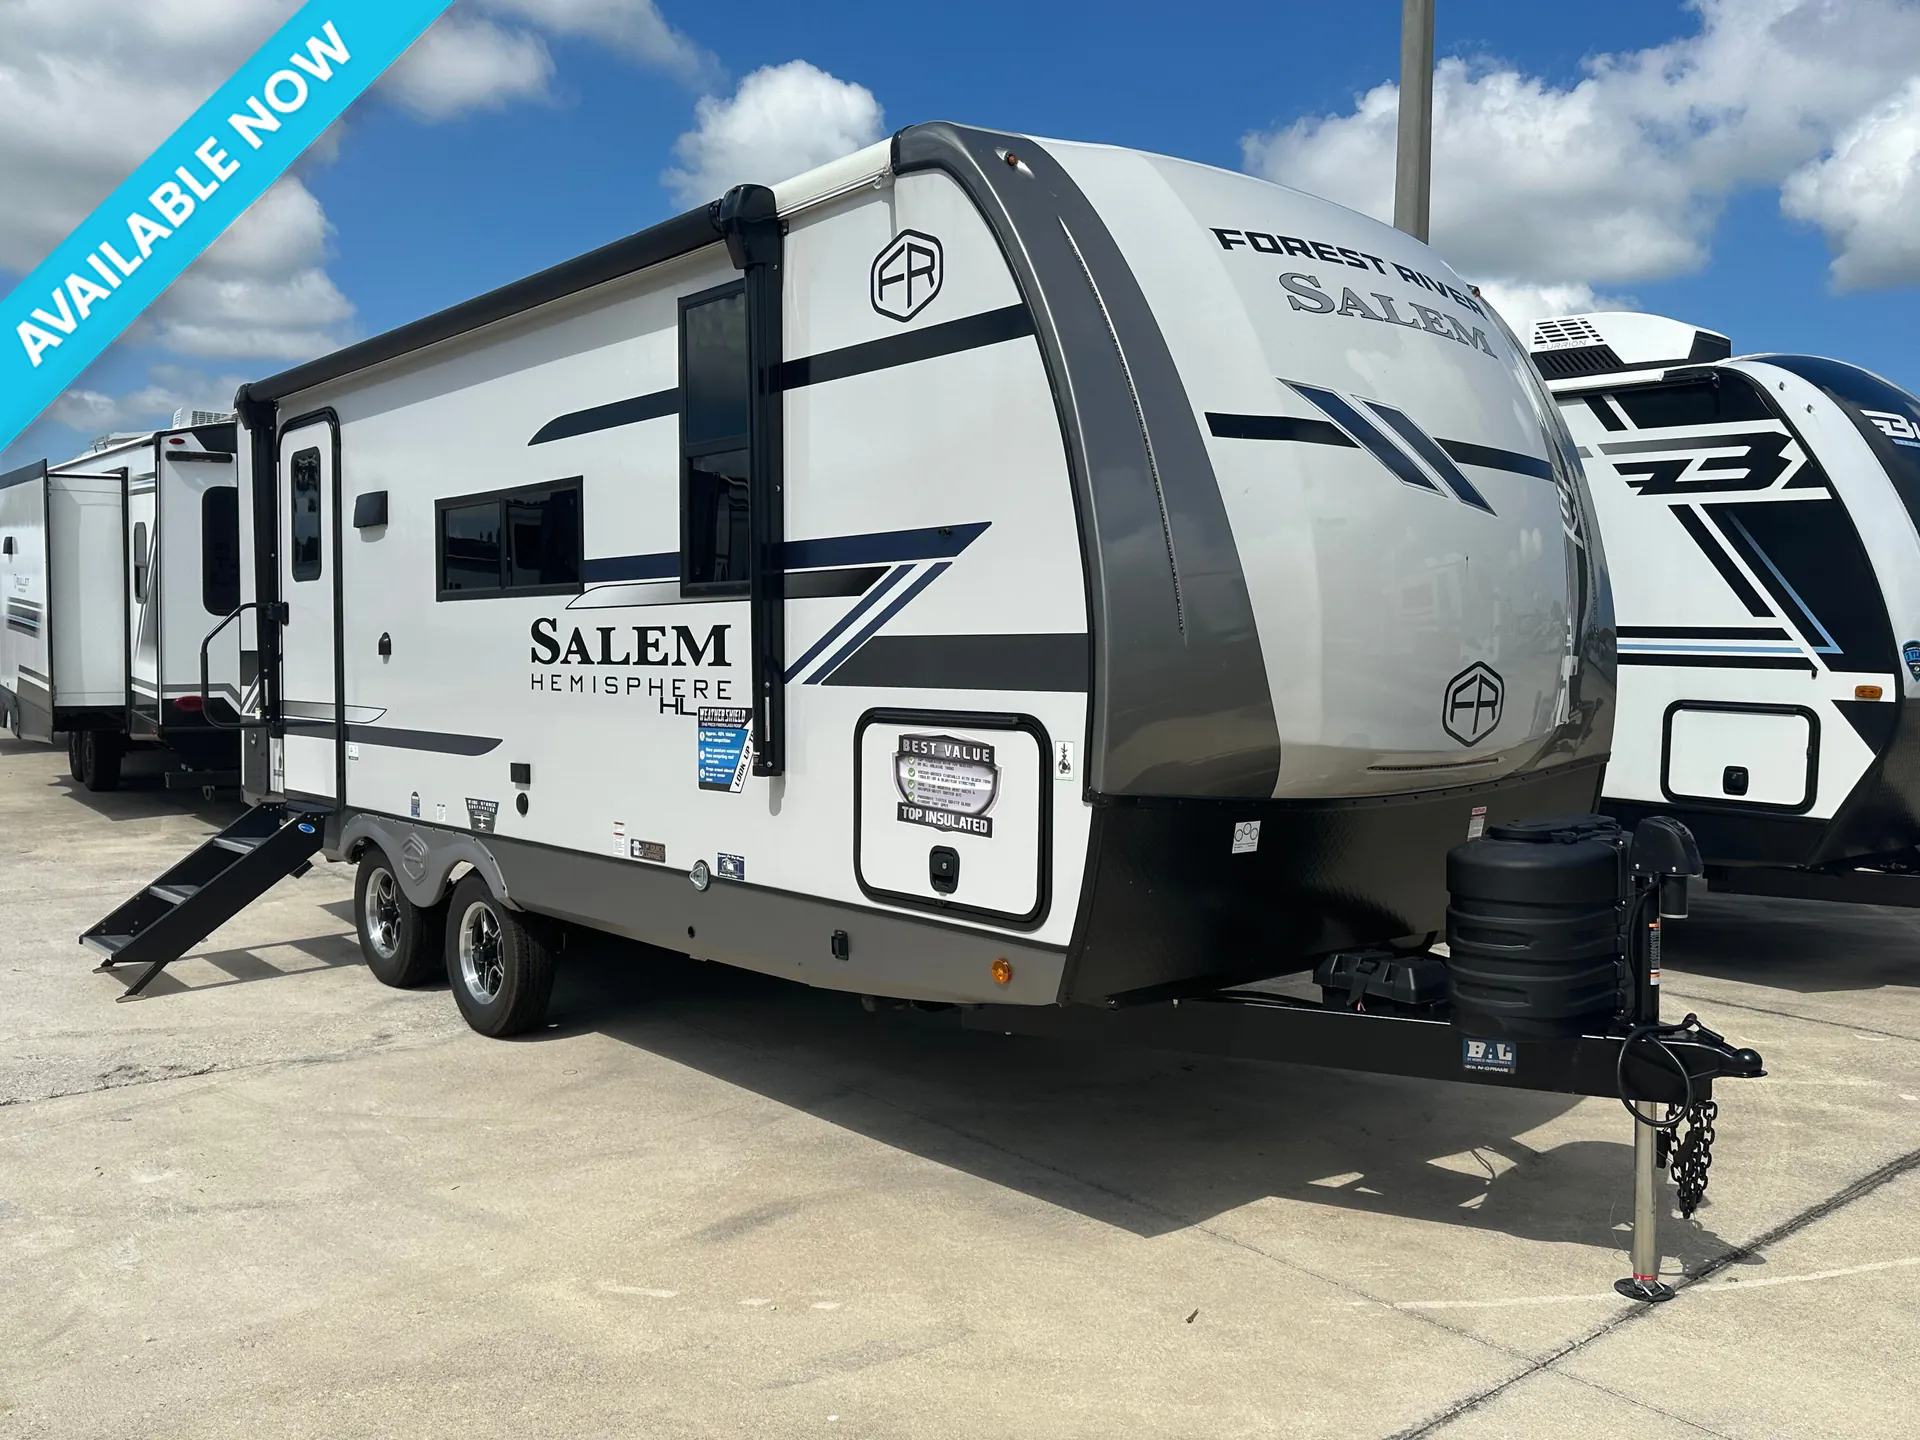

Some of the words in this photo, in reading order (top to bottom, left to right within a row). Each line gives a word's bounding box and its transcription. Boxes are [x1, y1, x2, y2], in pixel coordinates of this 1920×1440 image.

[1209, 227, 1388, 275] FOREST
[1390, 262, 1489, 320] RIVER
[1278, 271, 1499, 360] SALEM
[1540, 340, 1587, 350] FURRION
[531, 617, 732, 667] SALEM
[531, 673, 732, 700] HEMISPHERE
[660, 697, 697, 716] HL
[725, 709, 746, 723] SHIELD
[902, 739, 937, 755] BEST
[945, 744, 990, 763] VALUE
[734, 763, 746, 787] LOOK
[743, 745, 750, 760] UP
[902, 806, 923, 821] TOP
[925, 810, 988, 834] INSULATED
